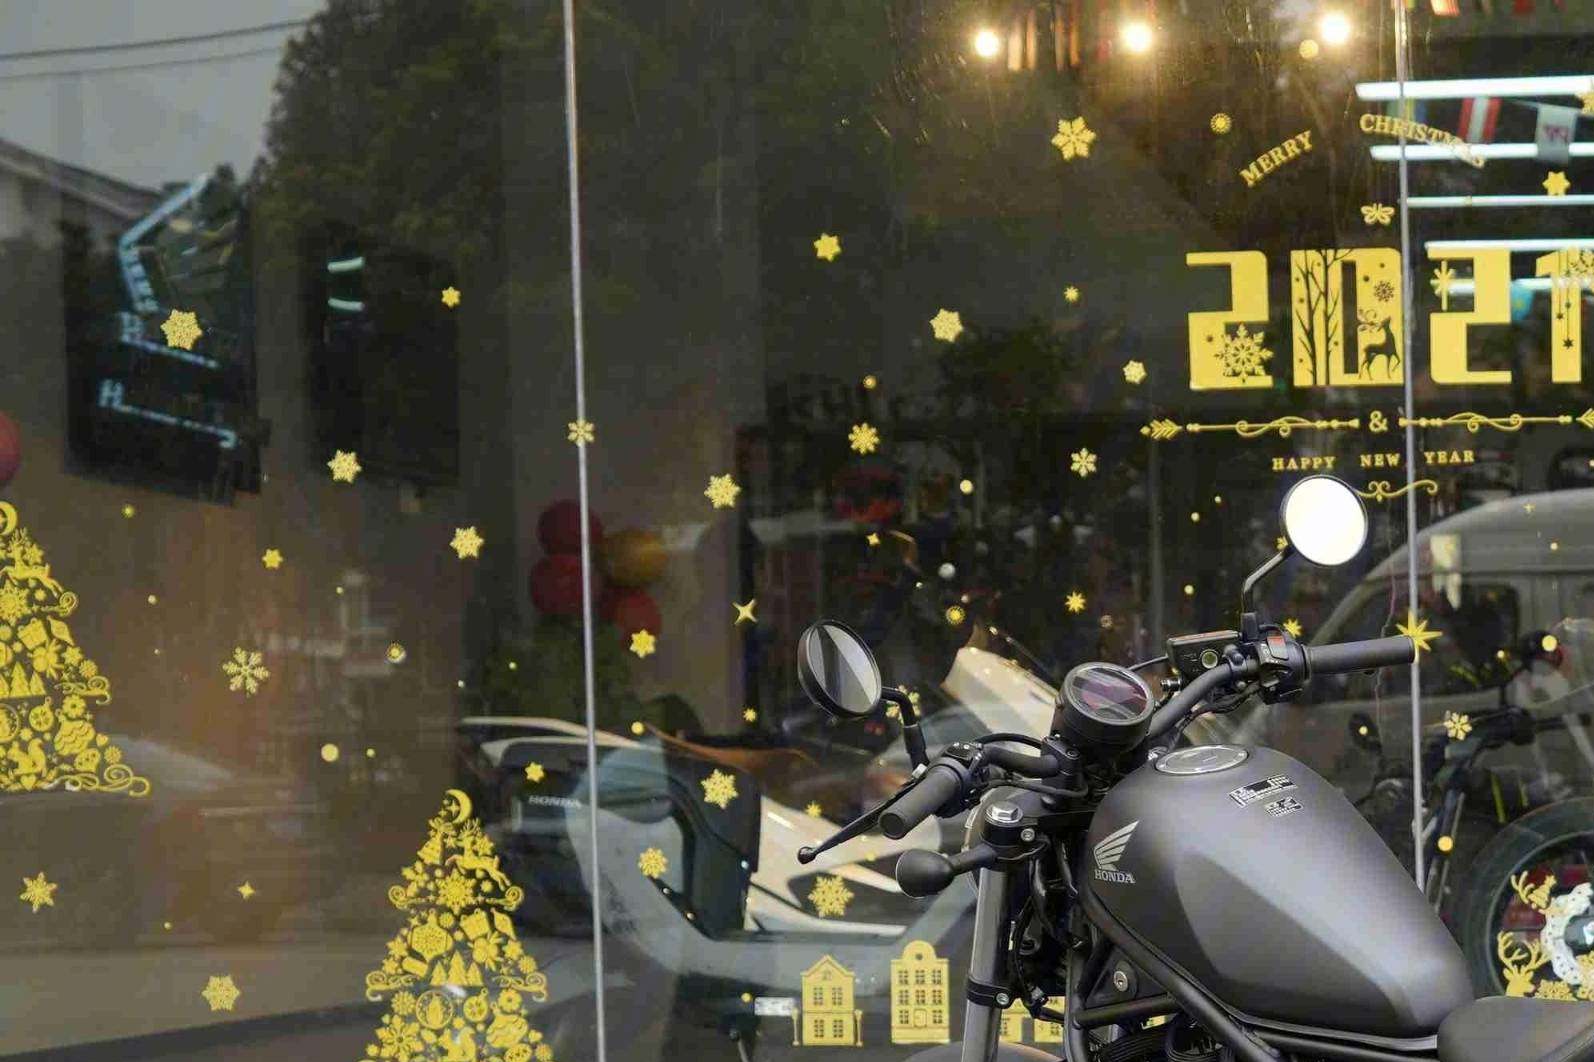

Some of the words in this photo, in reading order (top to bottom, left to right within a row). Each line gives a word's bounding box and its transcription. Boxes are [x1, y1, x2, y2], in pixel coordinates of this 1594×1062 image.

[1239, 130, 1313, 188] MERRY
[1186, 246, 1583, 390] 2021
[1369, 410, 1388, 433] &
[1272, 456, 1336, 471] HAPPY
[1360, 453, 1401, 468] NEW
[1424, 450, 1475, 464] YEAR
[529, 796, 582, 808] HONDA
[1094, 869, 1136, 884] HONDA
